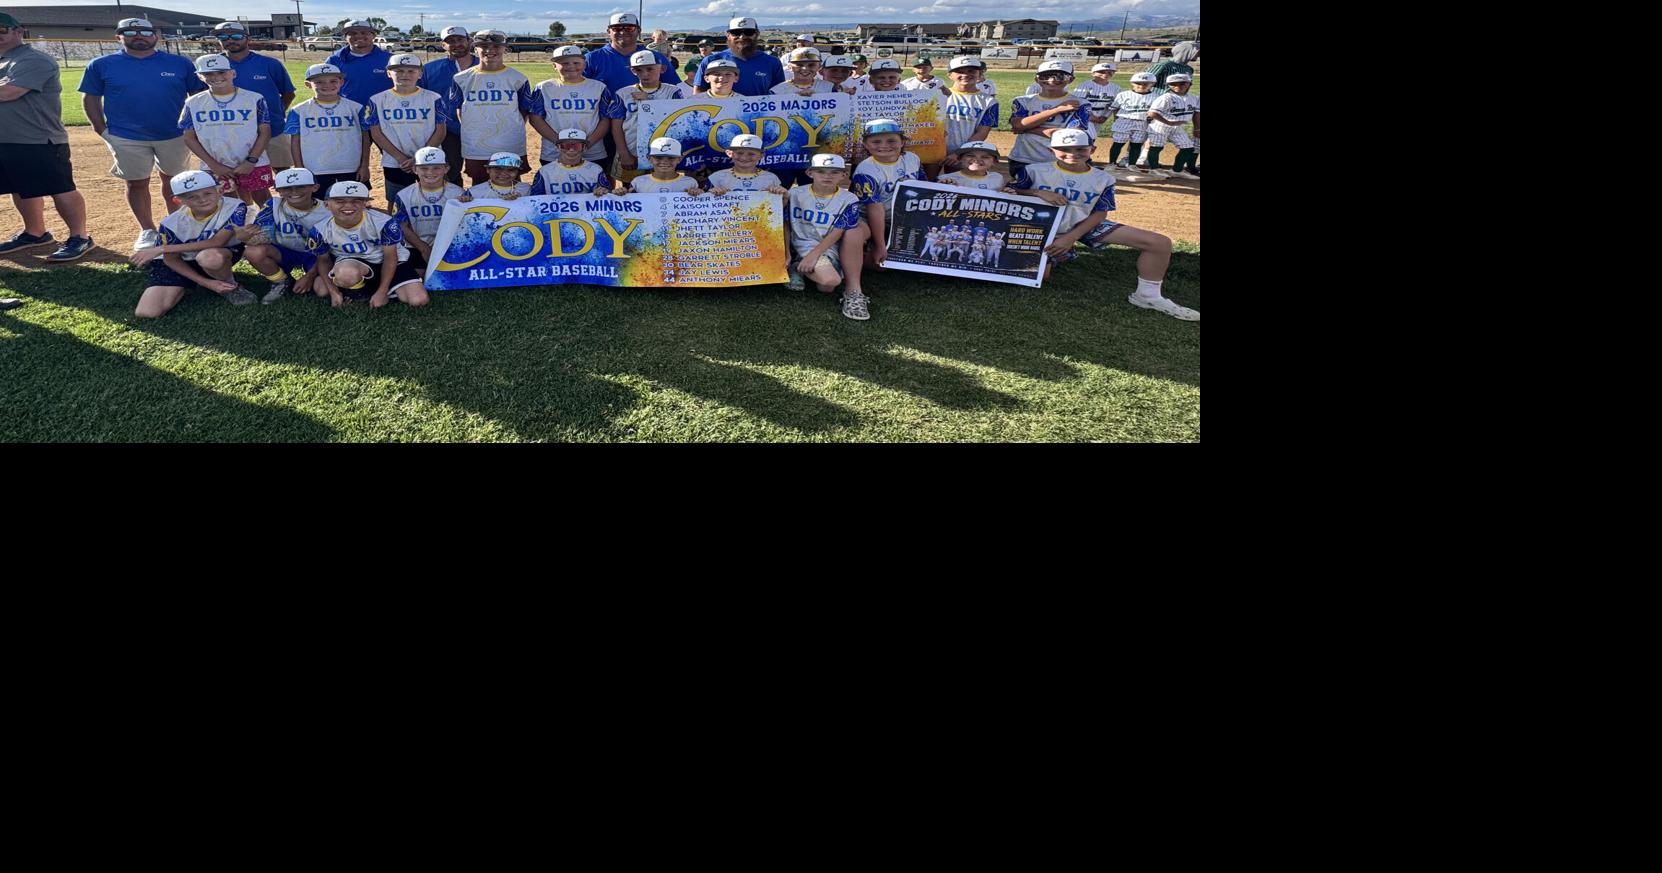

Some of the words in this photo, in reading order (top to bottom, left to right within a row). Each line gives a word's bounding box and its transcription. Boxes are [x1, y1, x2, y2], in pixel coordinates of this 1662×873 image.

[466, 89, 515, 102] CODY
[551, 98, 599, 110] CODY
[742, 101, 776, 113] 2026
[781, 99, 837, 111] MAJORS
[195, 109, 252, 123] CODY
[383, 108, 431, 120] CODY
[304, 116, 355, 128] CODY
[685, 156, 733, 167] ALL-ST
[757, 153, 810, 166] ASEBALL
[854, 182, 873, 198] 34
[410, 204, 444, 218] COD
[540, 201, 579, 214] 2026
[586, 200, 643, 213] MINORS
[905, 199, 958, 212] CODY
[960, 199, 1036, 221] MINORS
[436, 205, 645, 272] CODY
[469, 267, 546, 281] ALL-STAR
[552, 265, 618, 278] BASEBALL
